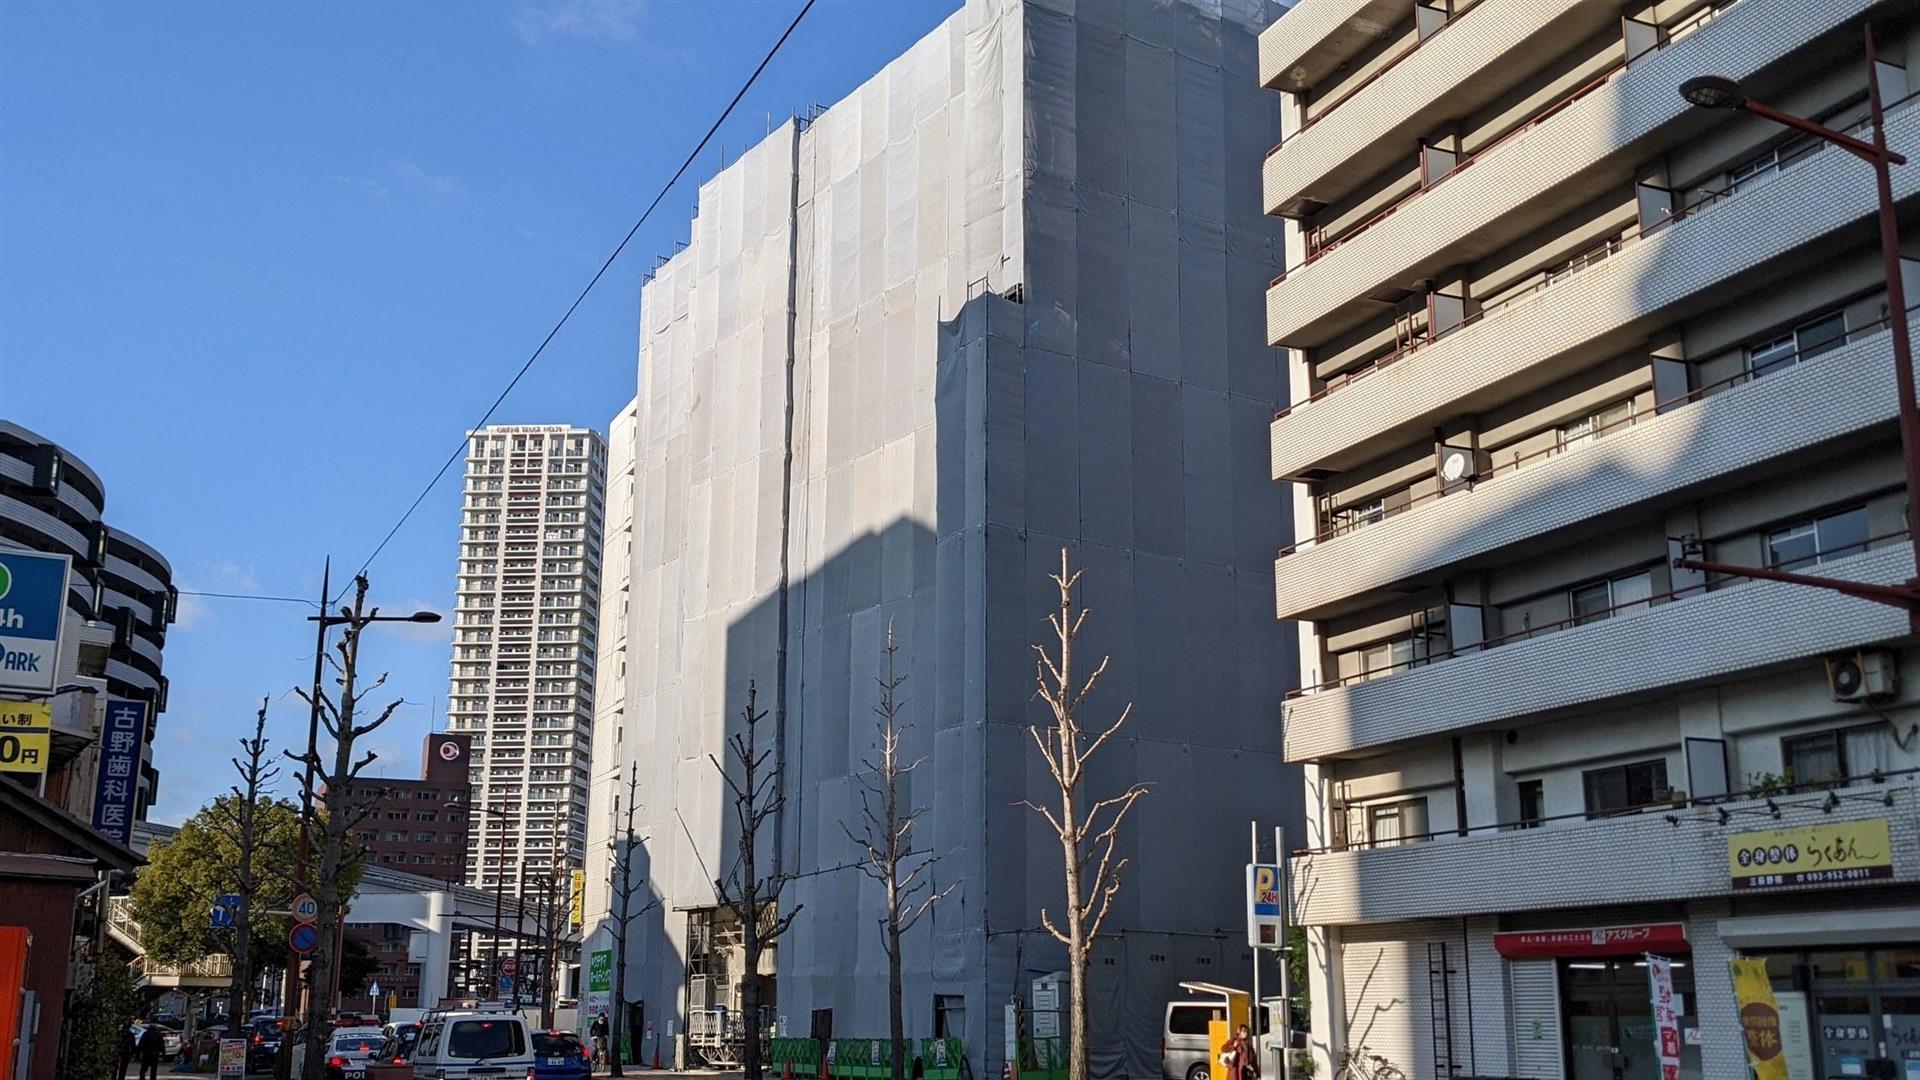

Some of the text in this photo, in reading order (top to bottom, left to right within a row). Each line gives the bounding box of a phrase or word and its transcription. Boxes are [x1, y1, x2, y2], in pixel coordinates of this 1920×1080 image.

[0, 643, 41, 672] ARK
[1738, 836, 1880, 868] 全身整体 らくあん
[1255, 867, 1274, 903] P
[1261, 892, 1280, 904] 24H
[299, 901, 315, 915] 40
